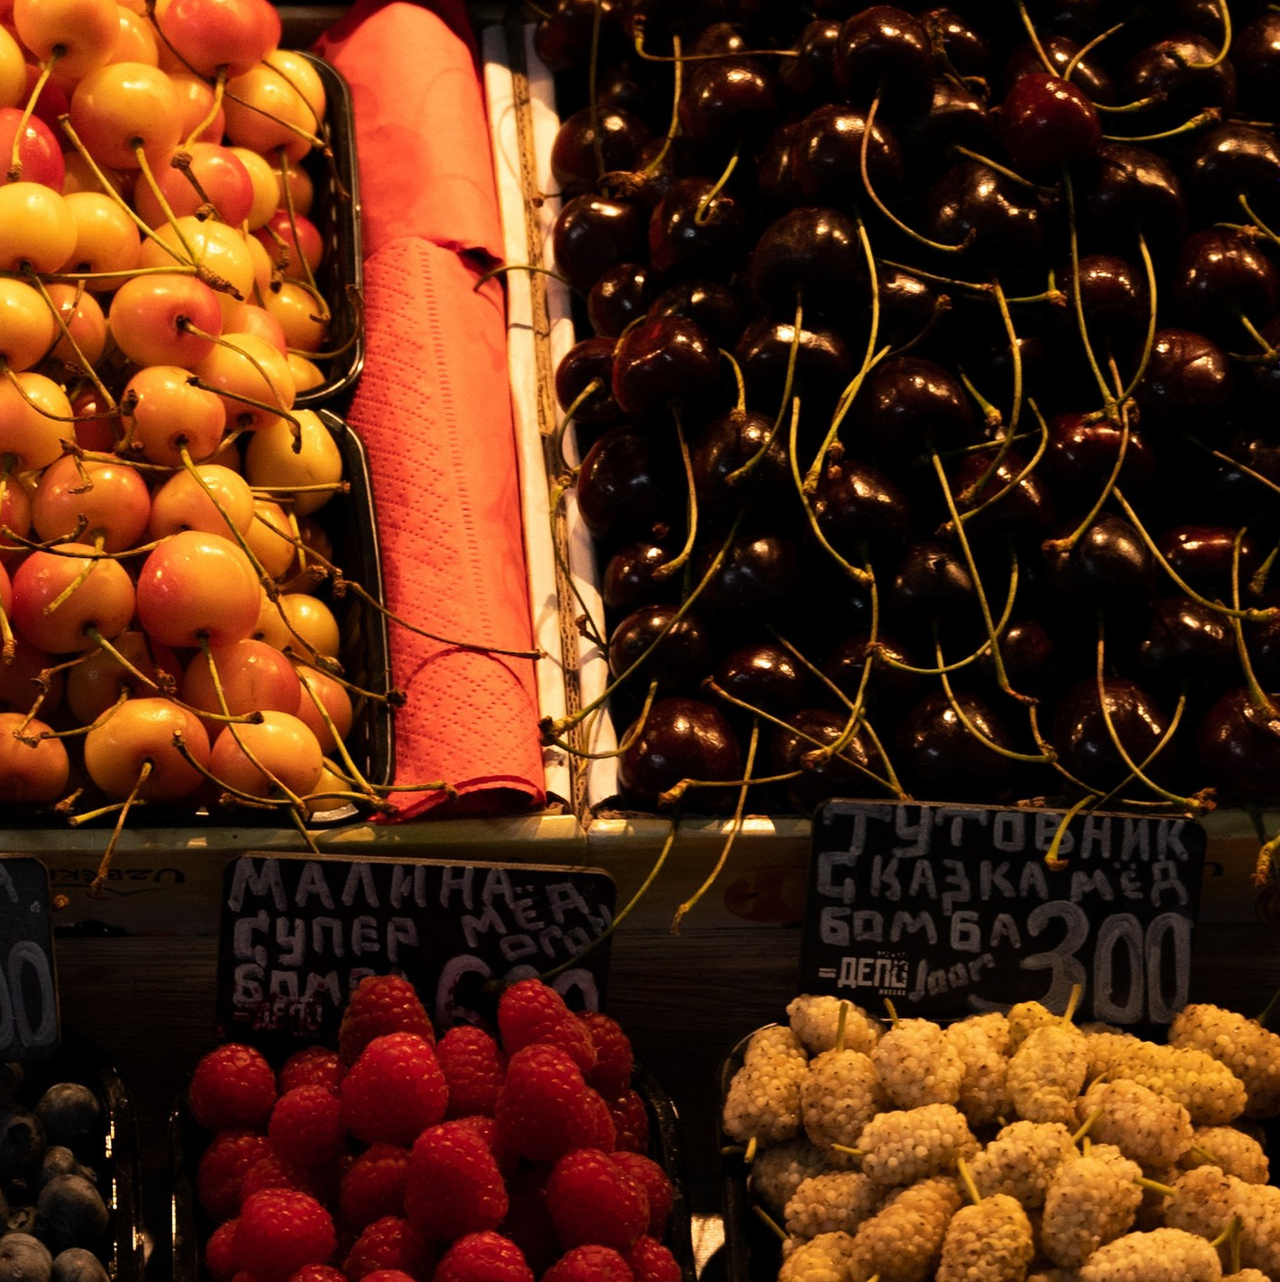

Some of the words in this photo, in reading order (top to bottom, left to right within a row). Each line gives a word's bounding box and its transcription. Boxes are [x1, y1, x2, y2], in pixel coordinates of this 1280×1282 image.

[823, 801, 1189, 858] ТУТОВНИК
[227, 856, 516, 913] МАЛИНА
[816, 851, 1049, 916] СКАЗКА
[1069, 860, 1189, 907] МЁД
[233, 910, 420, 968] СУПЕР
[820, 906, 1022, 953] БОМБА
[966, 899, 1193, 1025] 300
